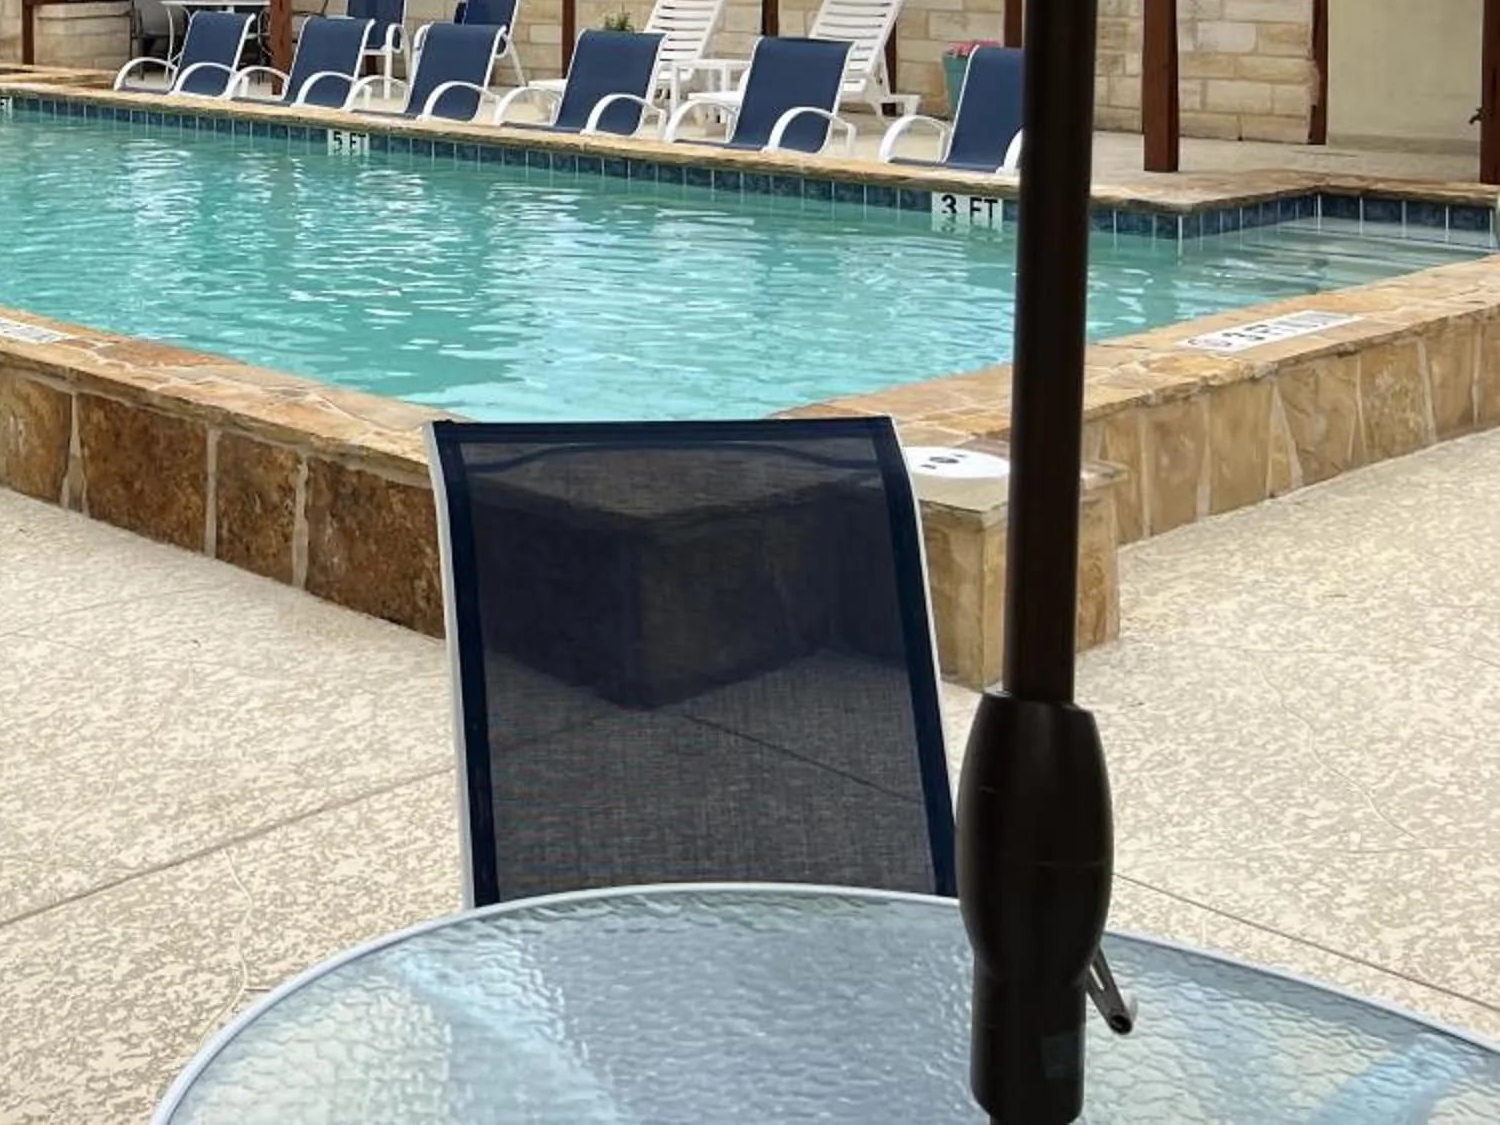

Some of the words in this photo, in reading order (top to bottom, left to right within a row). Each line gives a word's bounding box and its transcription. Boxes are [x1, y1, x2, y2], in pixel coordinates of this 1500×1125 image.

[333, 130, 343, 152] 5
[350, 132, 366, 155] FT
[941, 194, 957, 219] 3
[969, 196, 998, 225] FT
